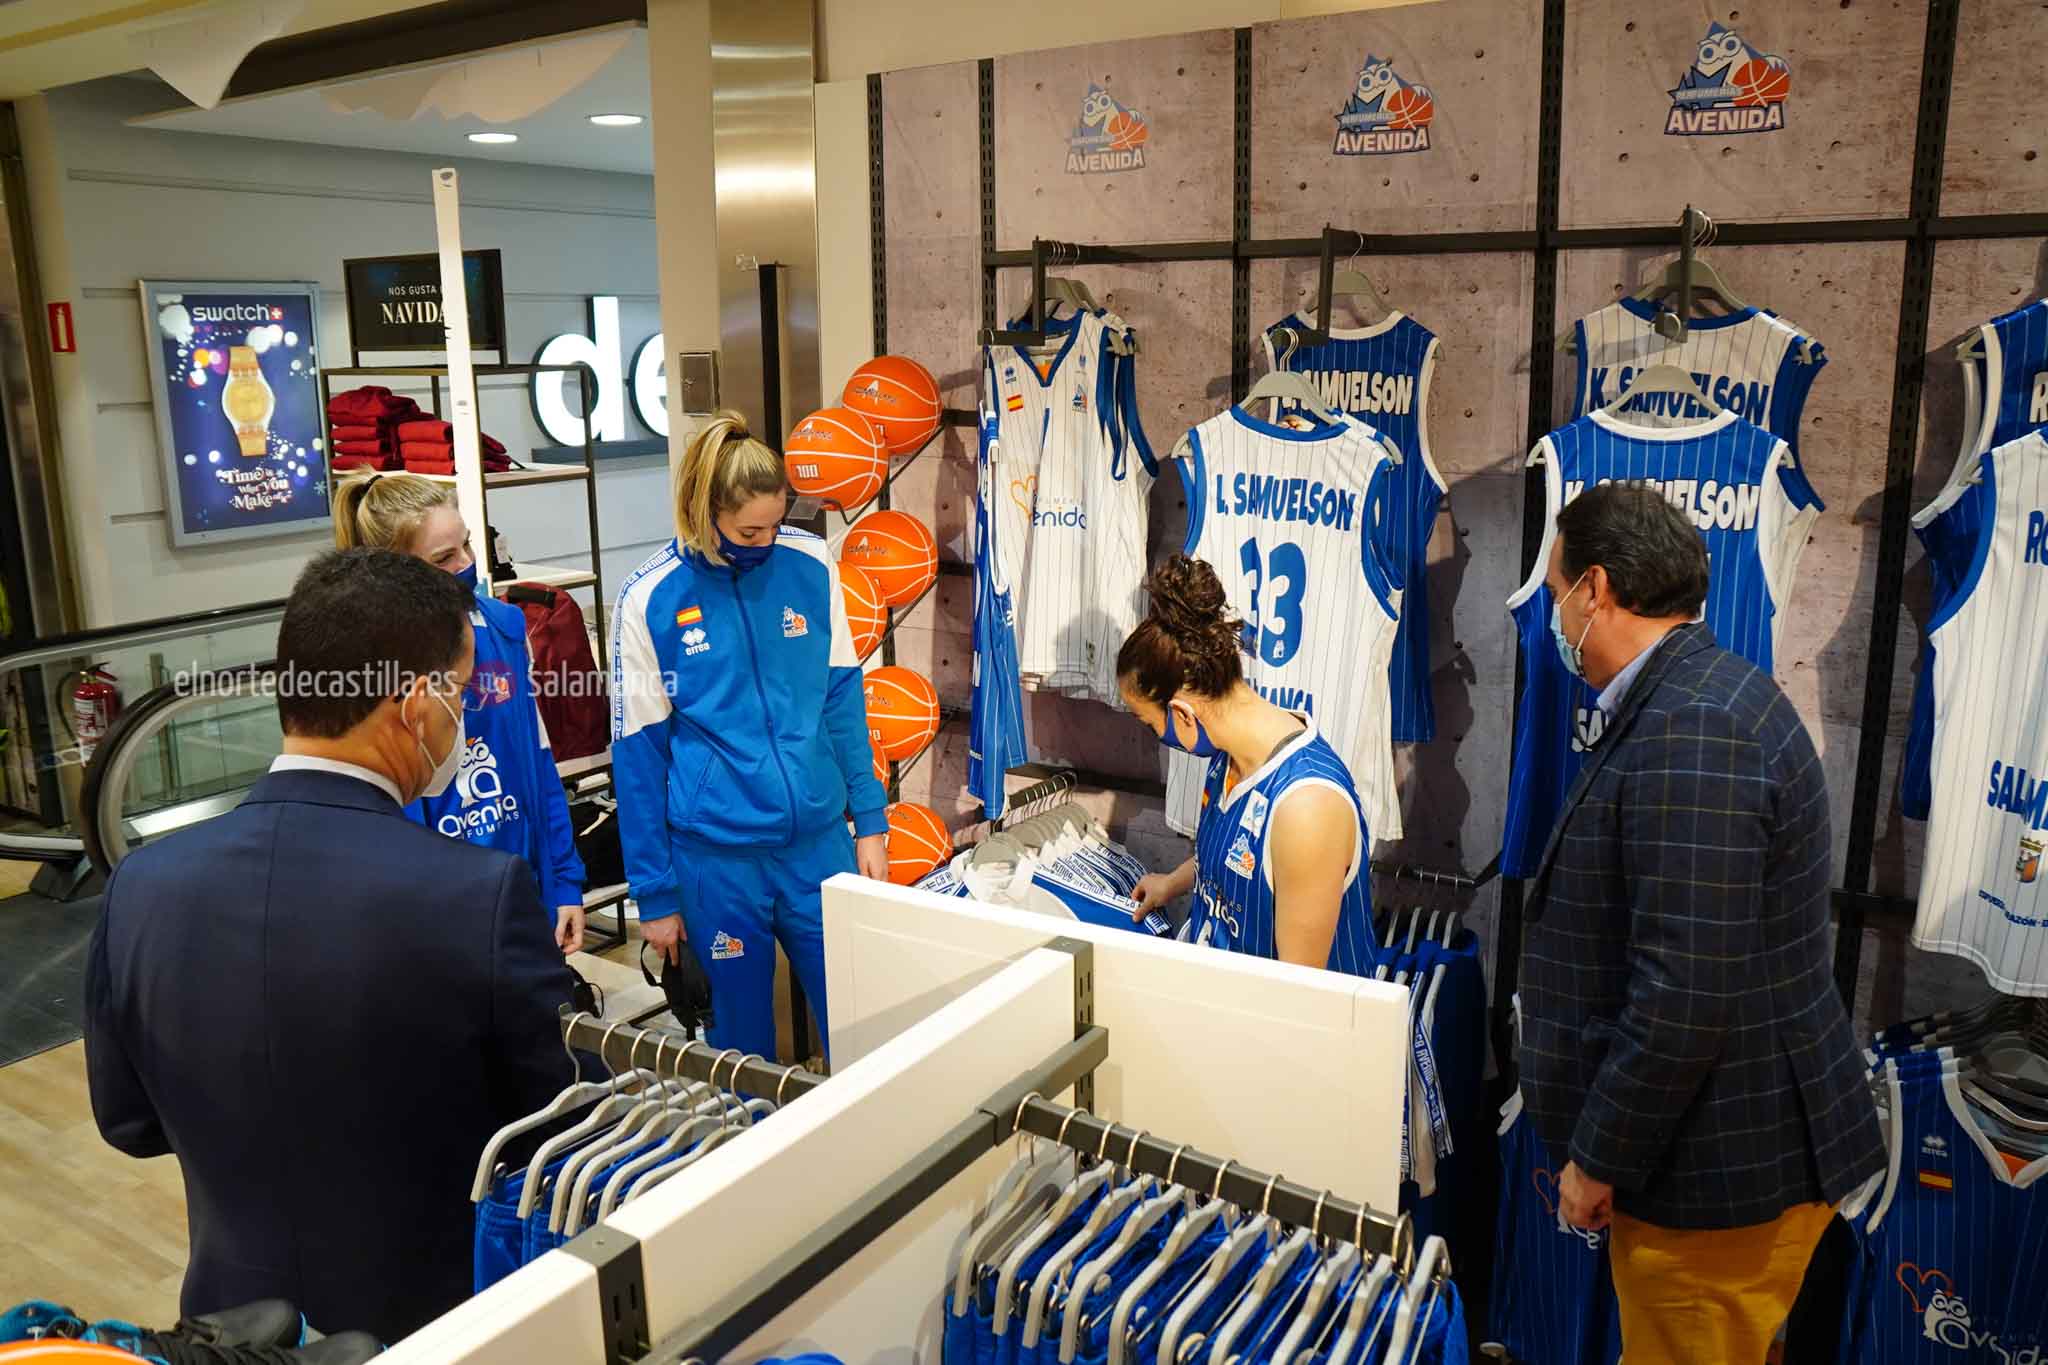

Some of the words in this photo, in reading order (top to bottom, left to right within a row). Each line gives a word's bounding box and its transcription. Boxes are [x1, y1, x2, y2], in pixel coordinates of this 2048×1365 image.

[1673, 103, 1781, 132] AVENIDA
[1335, 127, 1430, 153] AVENIDA
[1066, 147, 1144, 172] AVENIDA
[388, 286, 407, 296] NOS
[408, 284, 437, 295] GUSTA
[192, 304, 270, 321] swatch
[1216, 474, 1229, 516] L.
[1233, 472, 1356, 531] SAMUELSON
